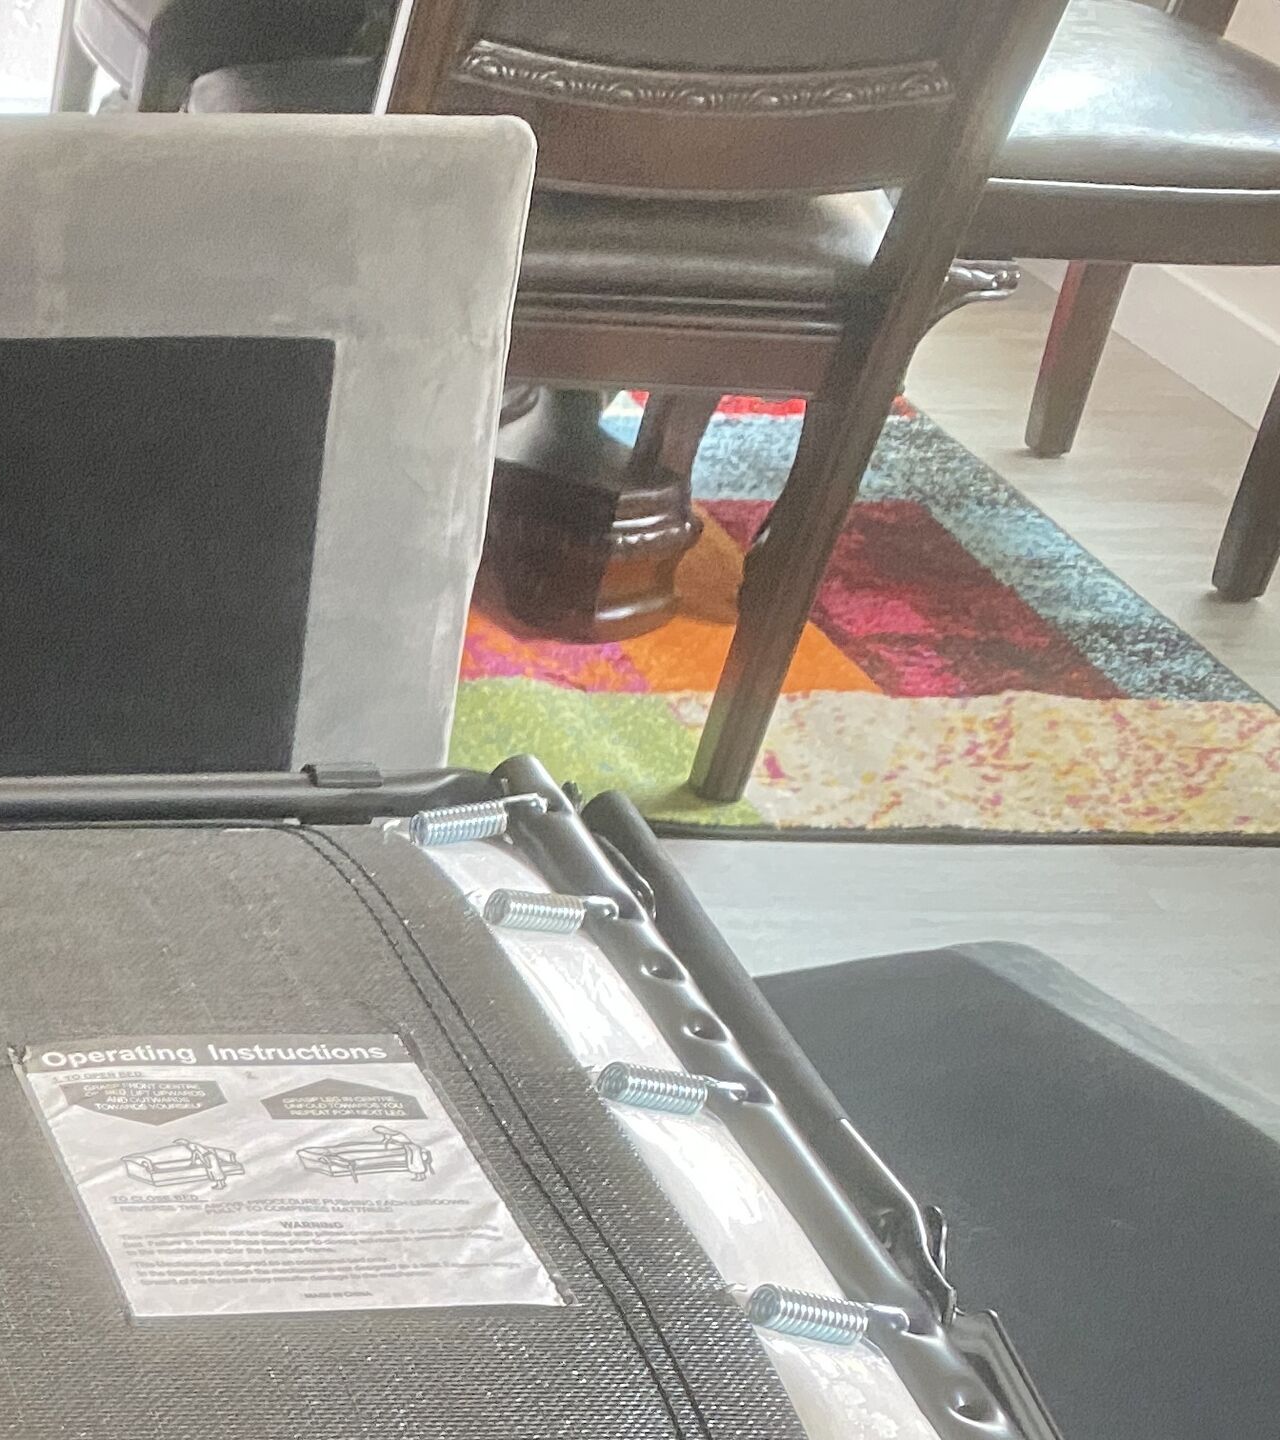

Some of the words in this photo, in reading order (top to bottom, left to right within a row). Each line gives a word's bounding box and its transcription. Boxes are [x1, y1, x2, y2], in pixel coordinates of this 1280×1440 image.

[41, 1043, 197, 1069] Operating
[209, 1041, 388, 1063] Instructions
[280, 1220, 344, 1230] WARNING
